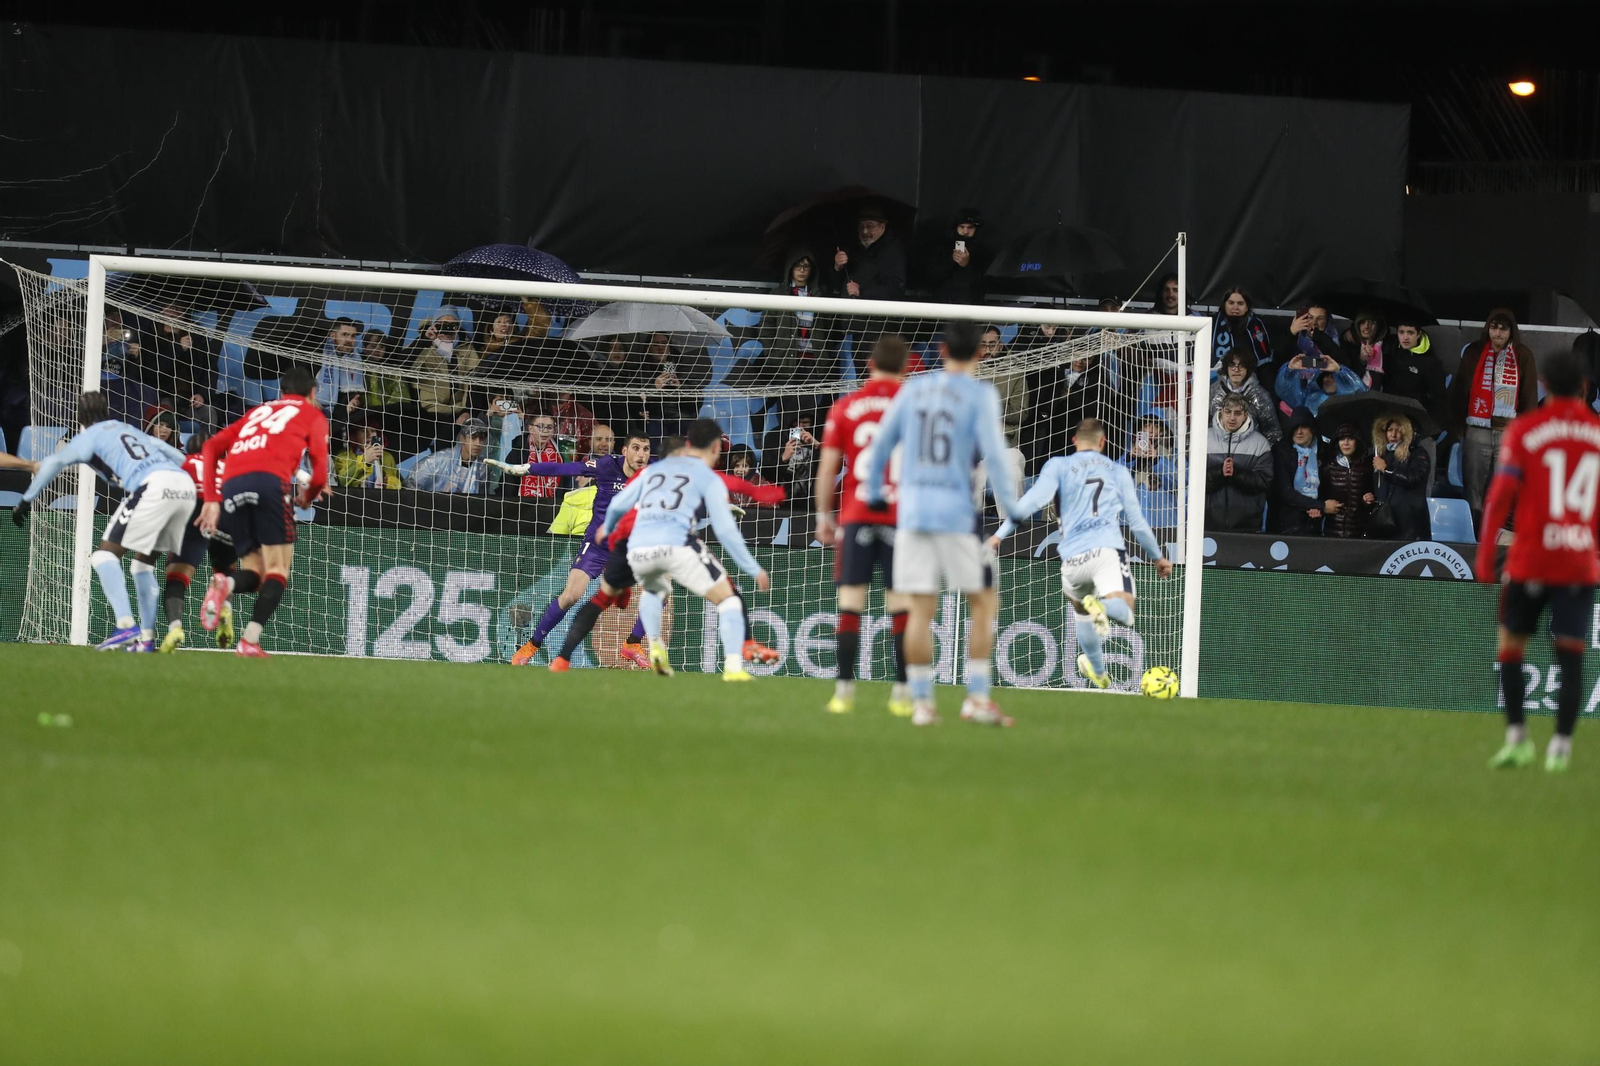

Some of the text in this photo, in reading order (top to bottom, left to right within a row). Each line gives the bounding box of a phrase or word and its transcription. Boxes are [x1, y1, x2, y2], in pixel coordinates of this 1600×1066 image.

[238, 405, 300, 438] 24
[917, 409, 954, 465] 16
[120, 433, 150, 460] 6
[230, 434, 268, 454] DIGI
[641, 473, 690, 510] 23
[1085, 478, 1104, 517] 7
[1541, 449, 1600, 523] 14
[582, 542, 591, 555] 1
[1386, 547, 1467, 579] ESTRELLA GALICIA
[340, 565, 495, 663] 125
